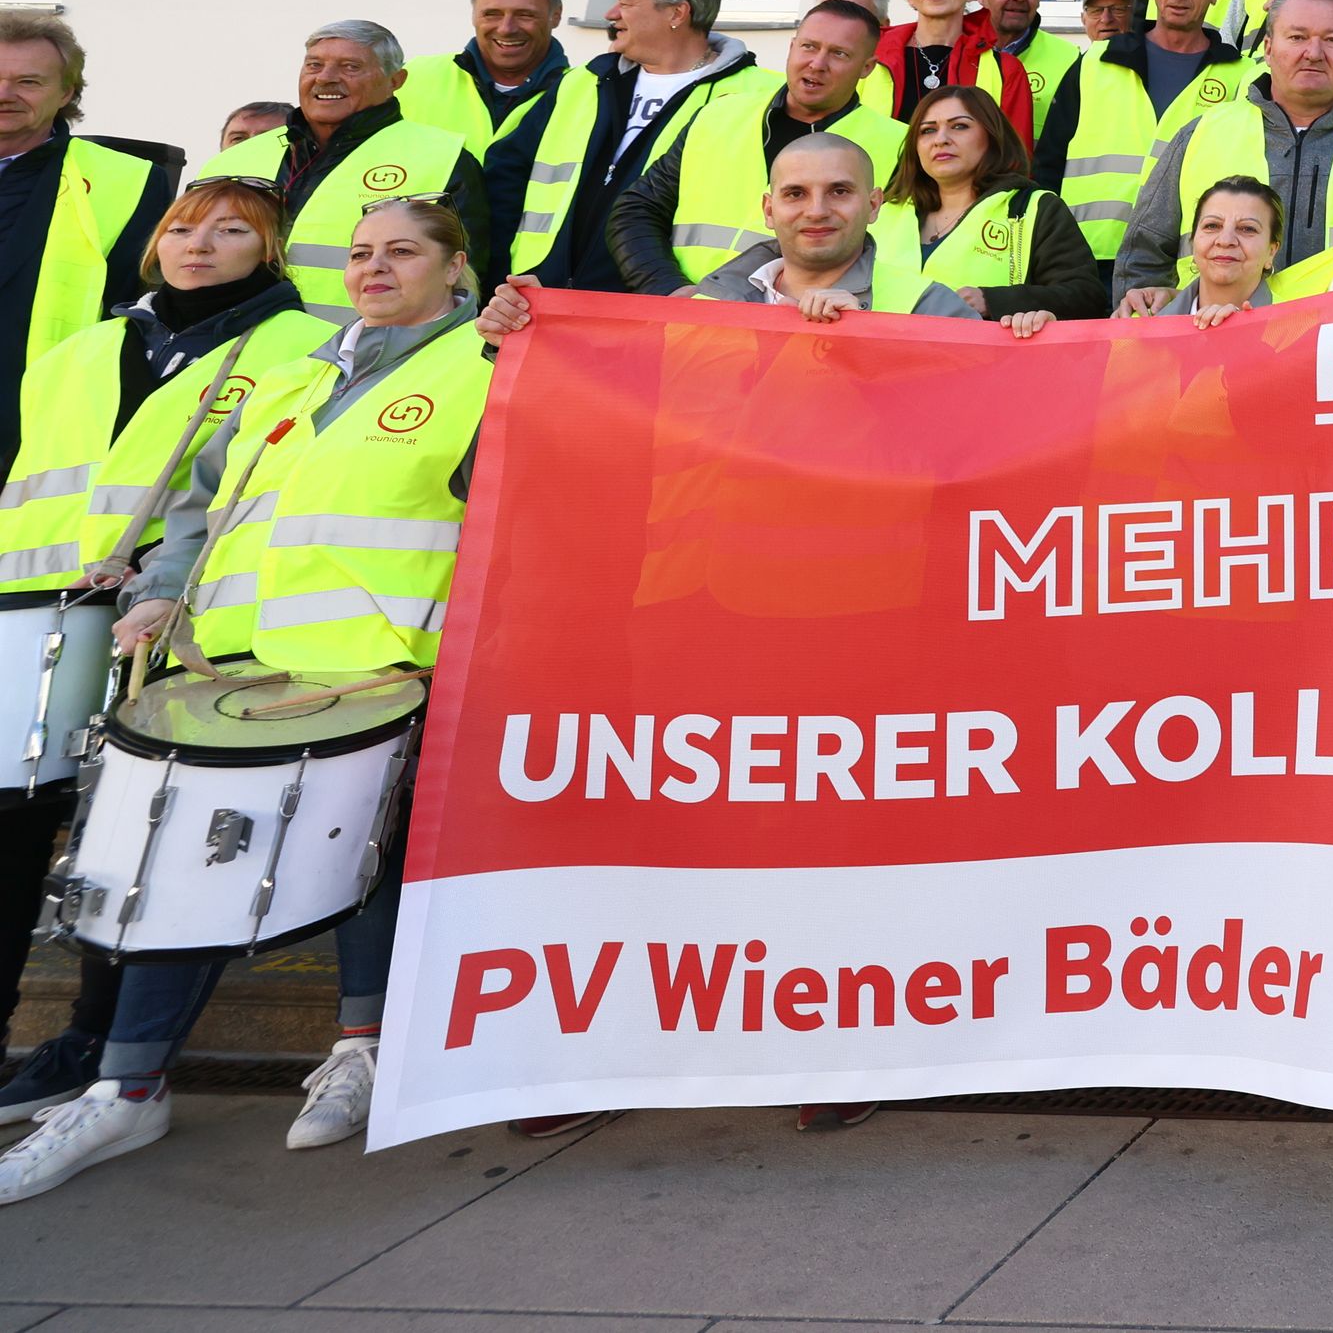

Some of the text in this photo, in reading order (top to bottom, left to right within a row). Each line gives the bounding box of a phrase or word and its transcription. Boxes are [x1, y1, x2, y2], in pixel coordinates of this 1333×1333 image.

[365, 435, 417, 446] younion.at
[499, 711, 1020, 803] UNSERER
[445, 915, 1323, 1050] PV Wiener Bäder
